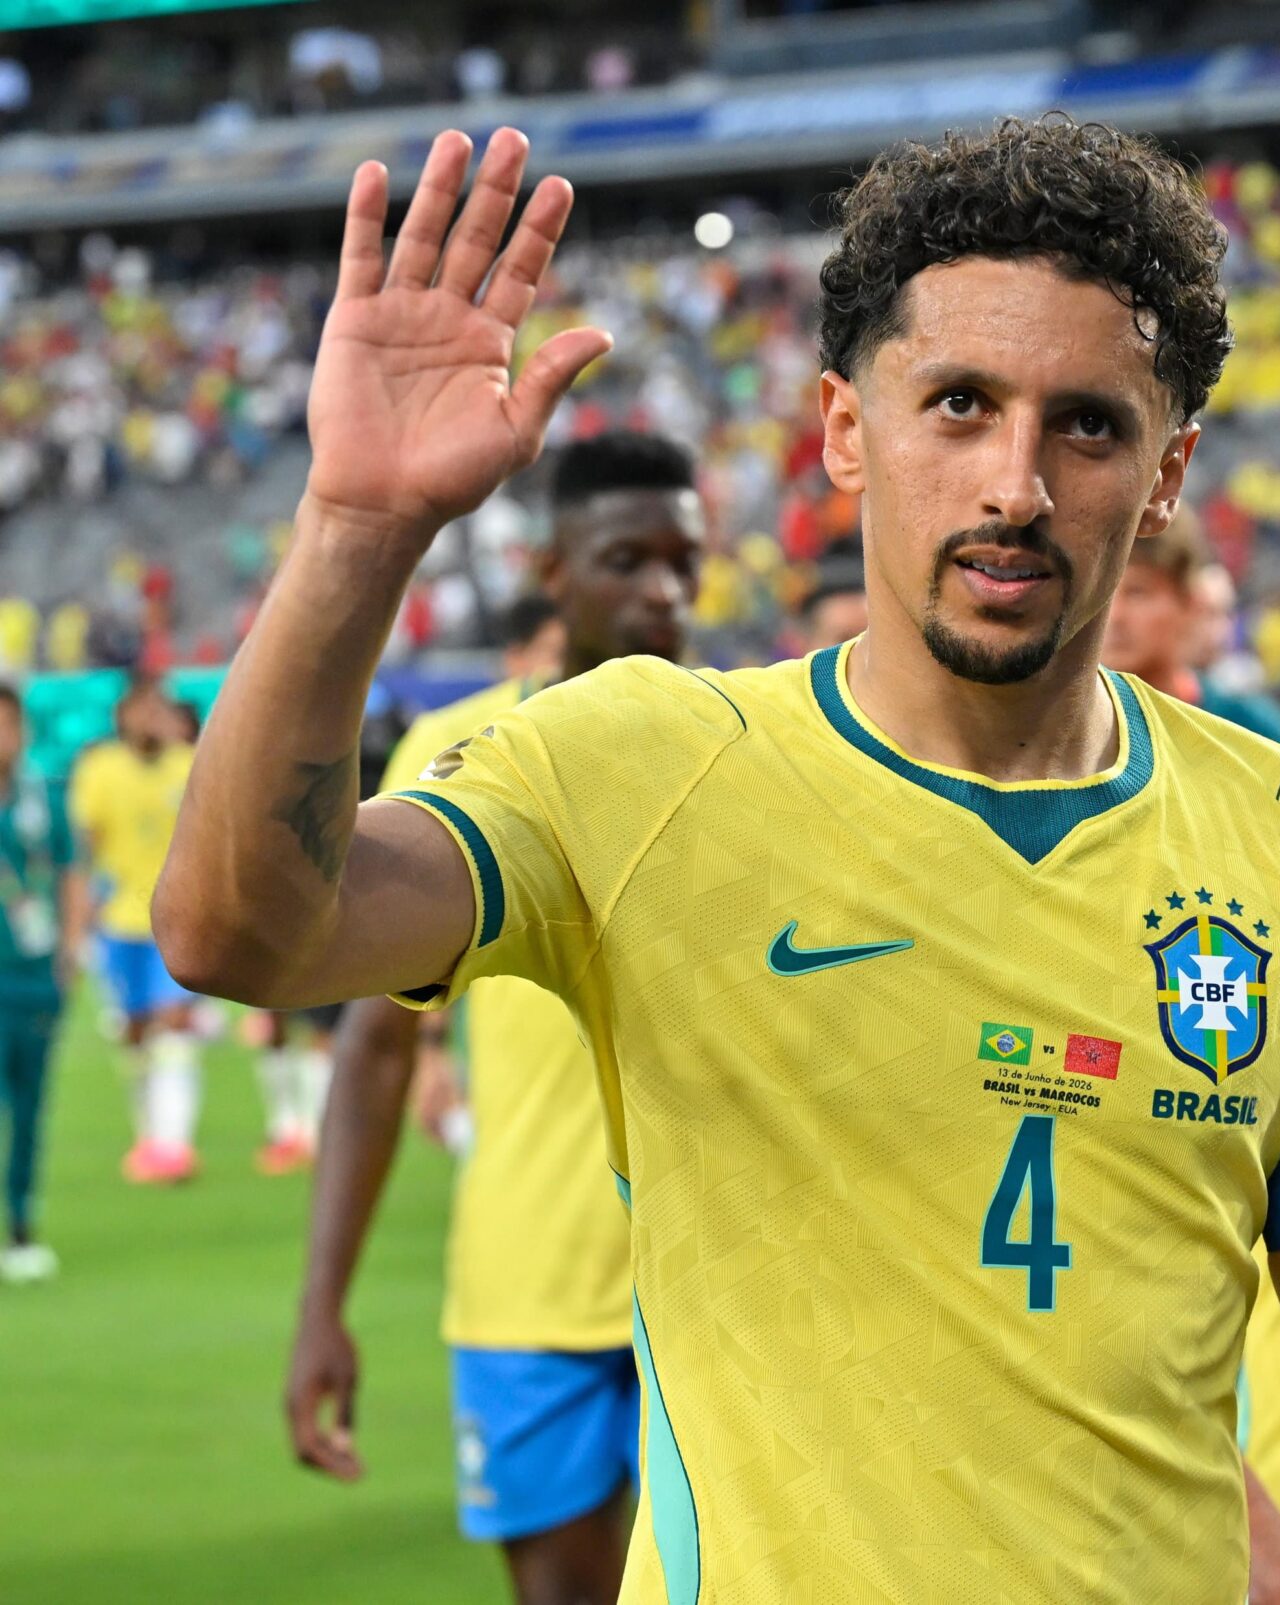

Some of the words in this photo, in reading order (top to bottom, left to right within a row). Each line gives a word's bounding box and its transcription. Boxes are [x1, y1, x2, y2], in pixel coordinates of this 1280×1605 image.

[1191, 982, 1235, 1003] CBF
[1043, 1045, 1055, 1055] vs
[998, 1068, 1008, 1077] 13
[1011, 1070, 1022, 1080] de
[1025, 1072, 1051, 1083] Junho
[1054, 1076, 1065, 1086] de
[1069, 1079, 1092, 1090] 2026
[983, 1079, 1020, 1095] BRASIL
[1024, 1088, 1036, 1096] vs
[1040, 1087, 1101, 1108] MARROCOS
[1001, 1096, 1021, 1106] New
[1023, 1099, 1051, 1112] Jersey
[1058, 1104, 1078, 1115] EUA
[1151, 1089, 1258, 1126] BRASIL
[979, 1113, 1072, 1312] 4
